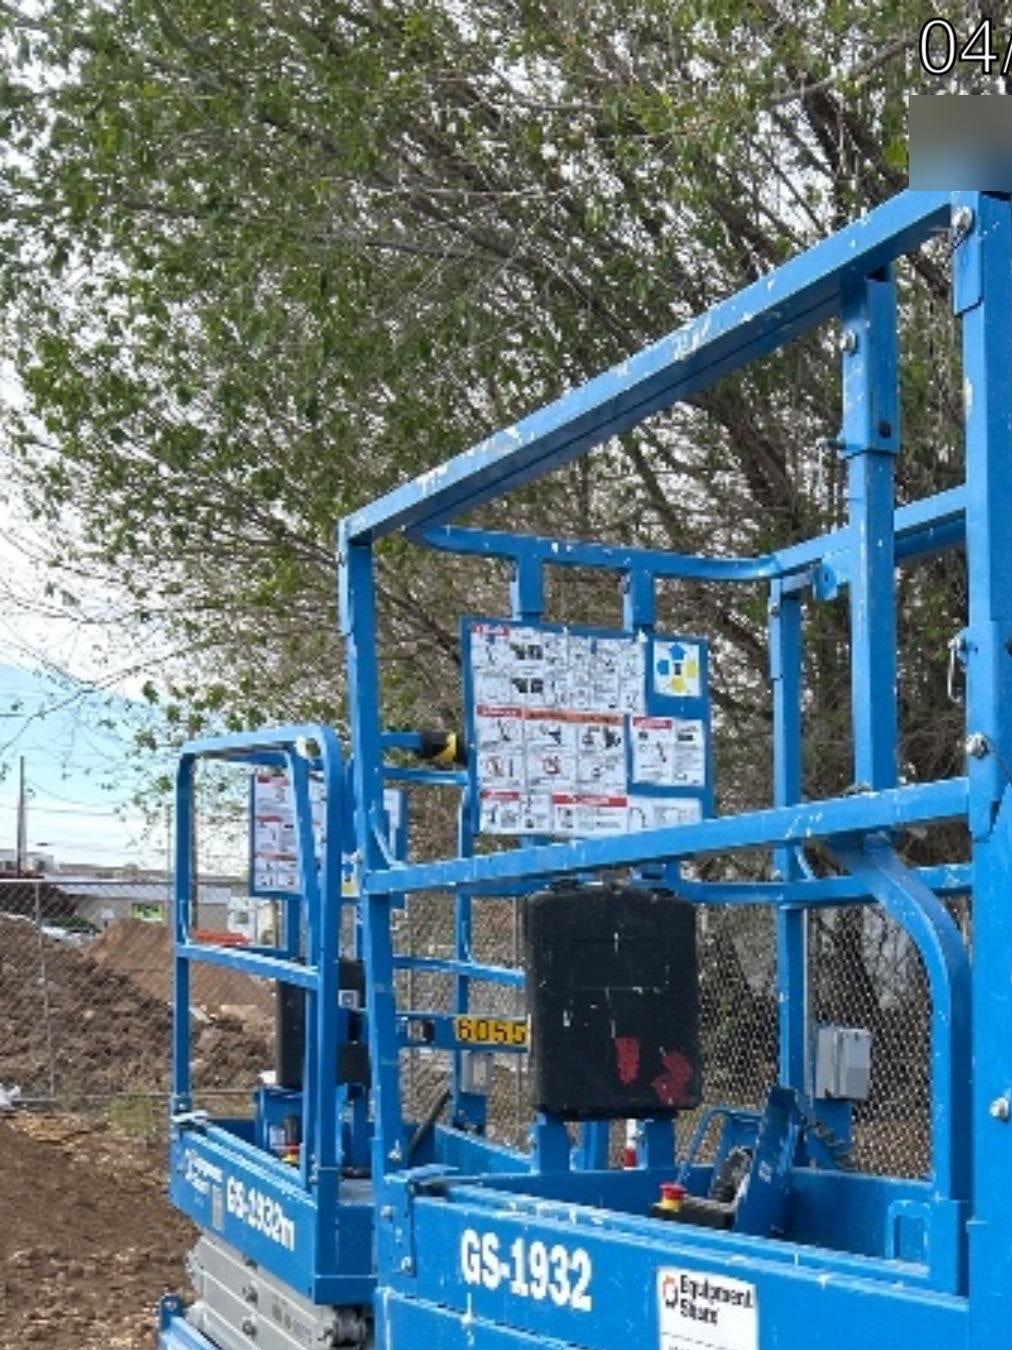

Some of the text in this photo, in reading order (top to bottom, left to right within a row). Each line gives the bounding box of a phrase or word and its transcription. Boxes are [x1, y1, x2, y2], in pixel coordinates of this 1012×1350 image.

[460, 1229, 592, 1312] GS-1932
[680, 1274, 754, 1308] Equipment
[680, 1299, 718, 1325] Share
